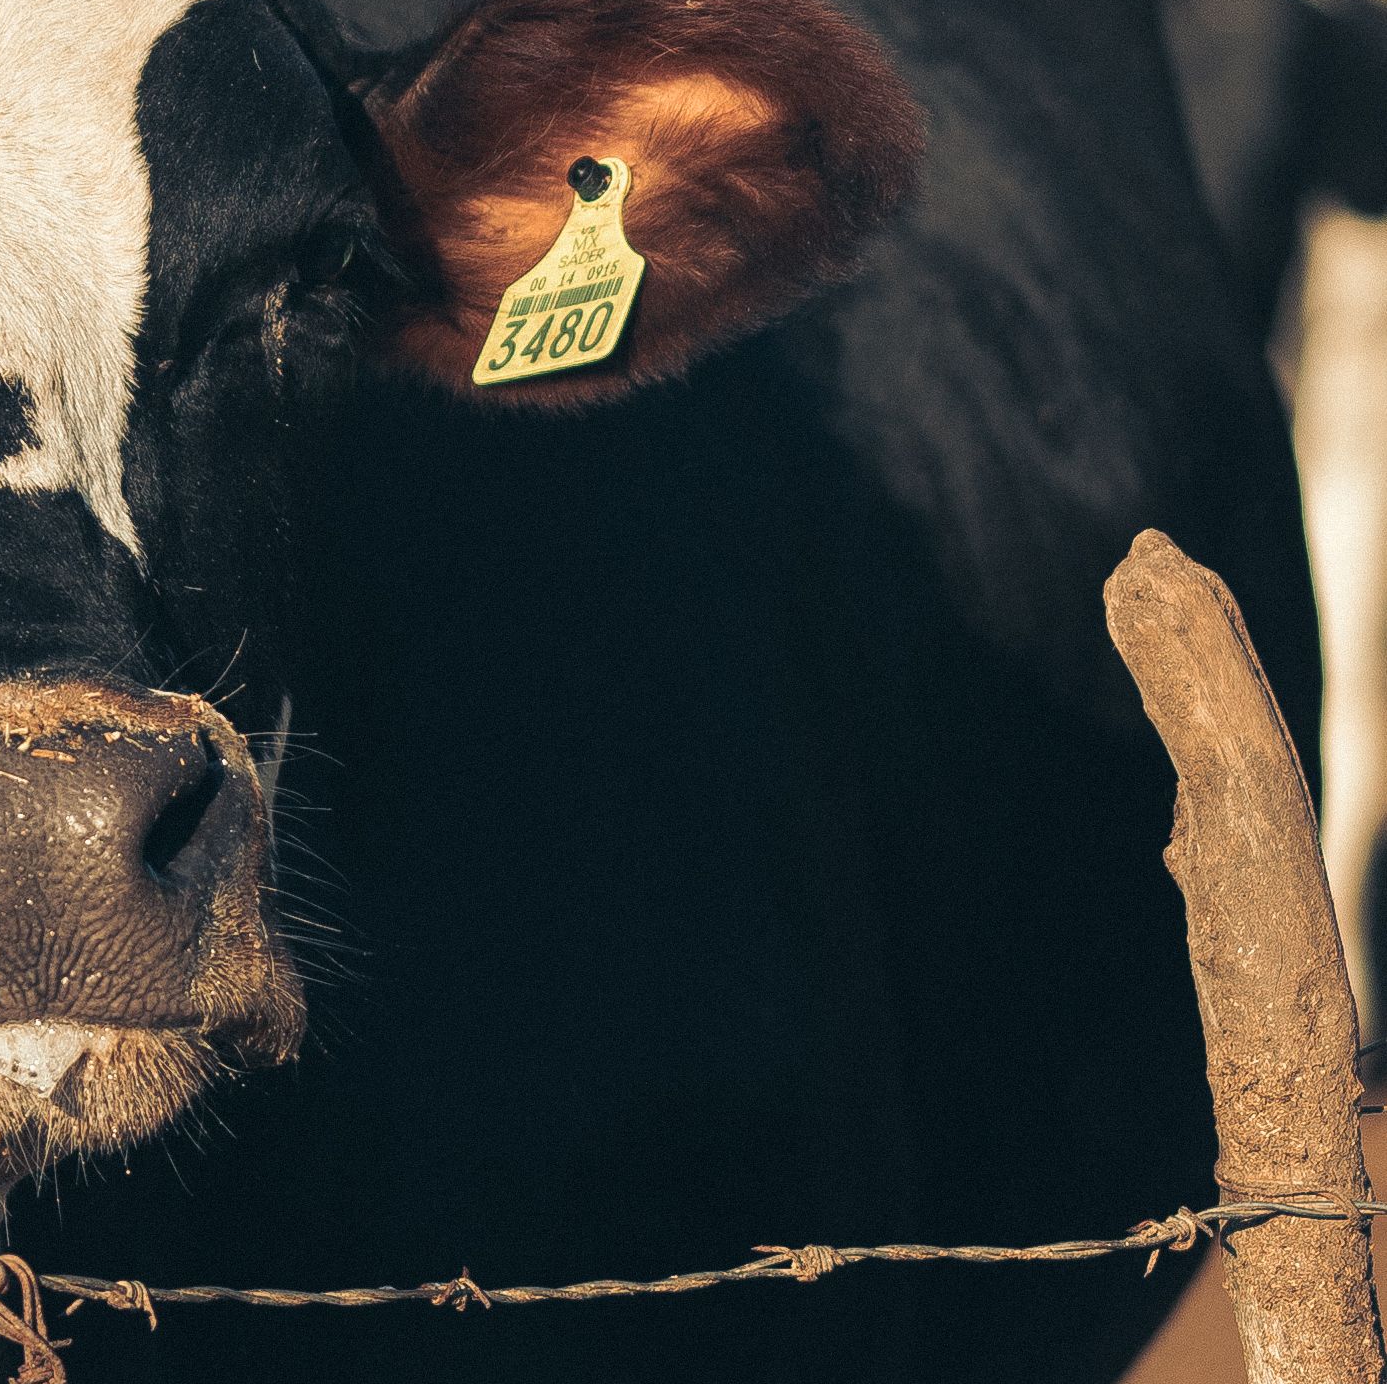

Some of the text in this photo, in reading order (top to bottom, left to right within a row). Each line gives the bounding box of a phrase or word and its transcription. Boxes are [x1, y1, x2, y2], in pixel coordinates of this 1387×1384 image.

[572, 236, 598, 252] MX
[558, 248, 605, 268] SADER
[530, 260, 617, 291] 00 14 0915
[489, 301, 614, 371] 3480
